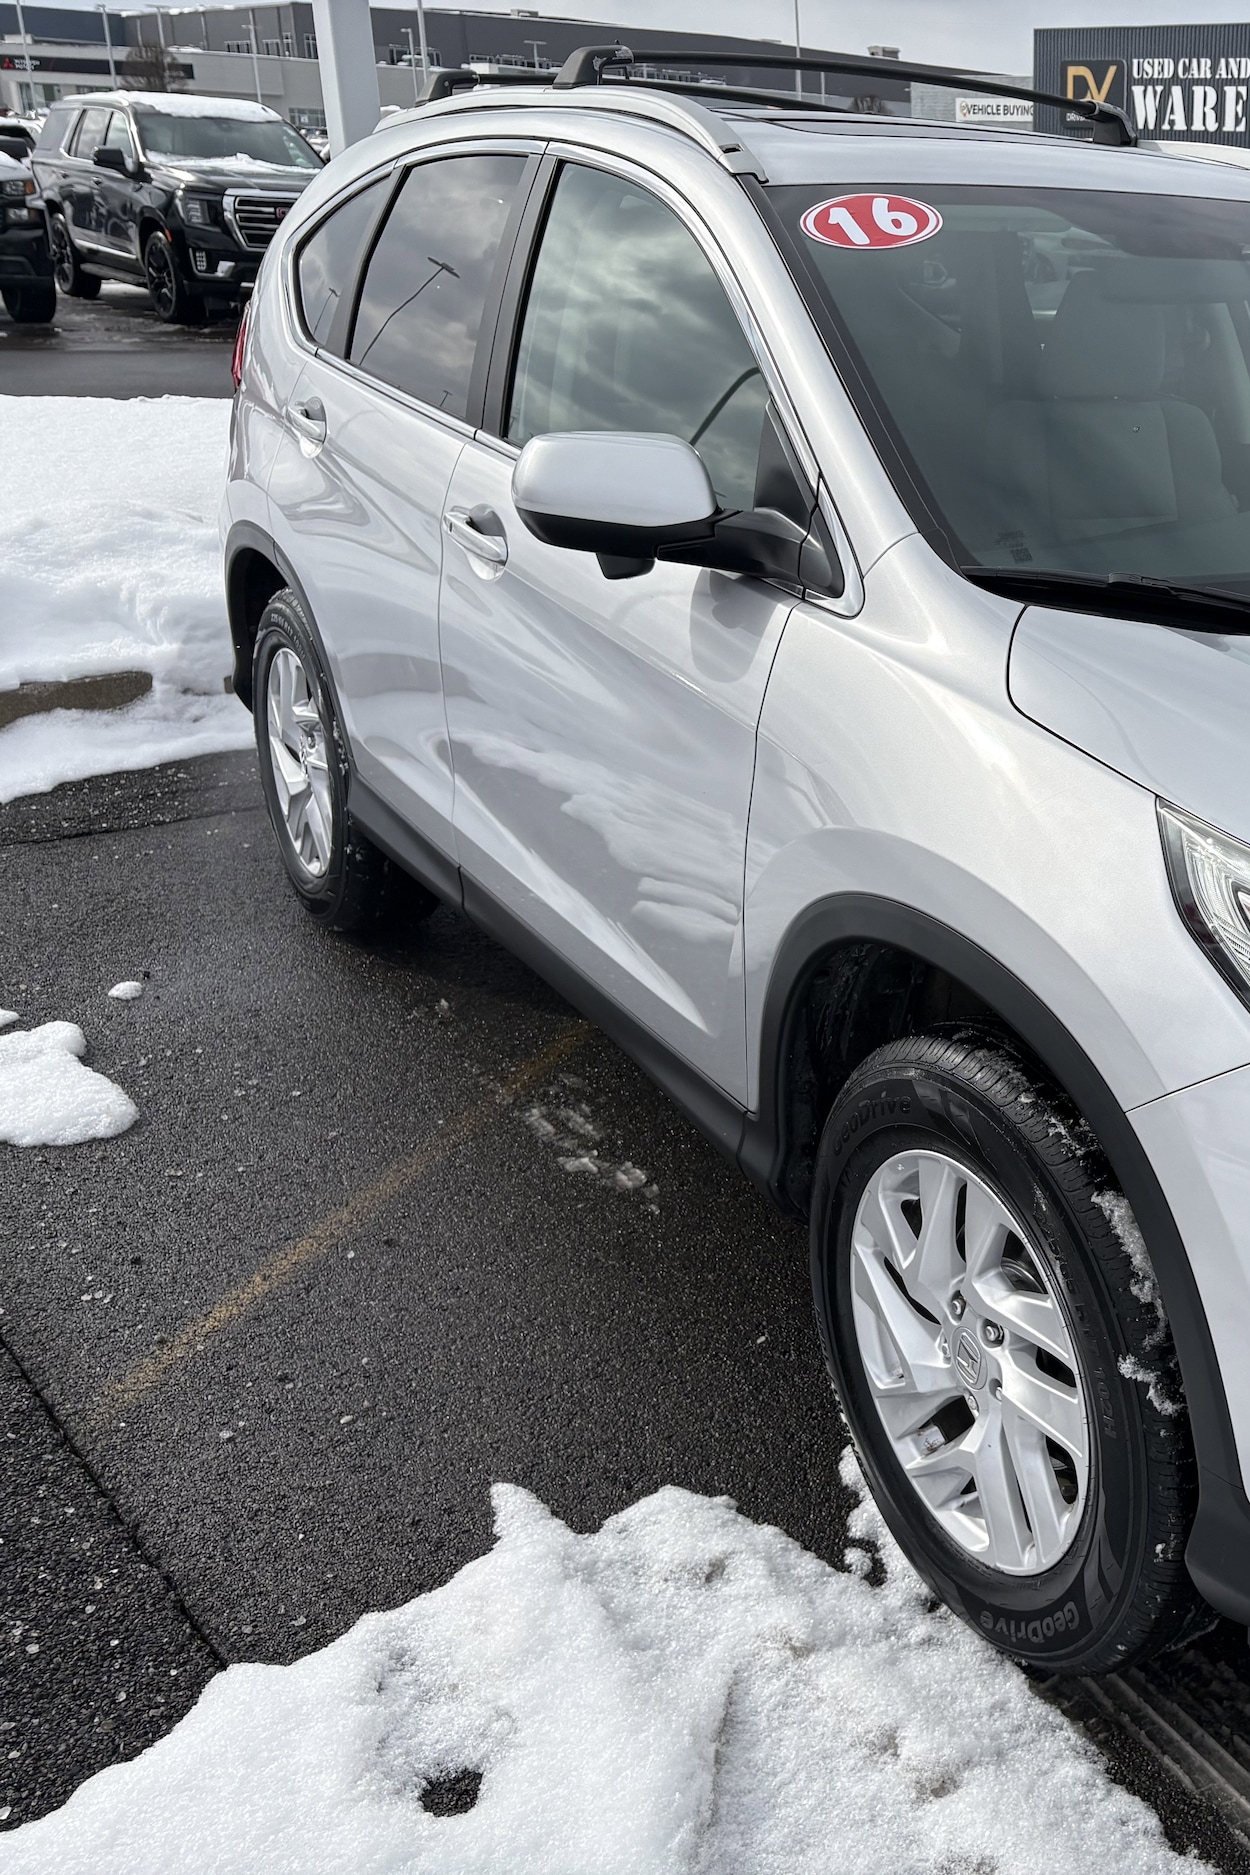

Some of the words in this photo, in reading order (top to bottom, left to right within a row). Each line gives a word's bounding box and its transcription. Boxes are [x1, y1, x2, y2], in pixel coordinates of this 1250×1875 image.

[1132, 58, 1175, 79] USED
[1178, 58, 1212, 79] CAR
[967, 104, 1001, 116] VEHICLE
[828, 197, 918, 245] 16
[979, 1600, 1080, 1644] GeoDrive
